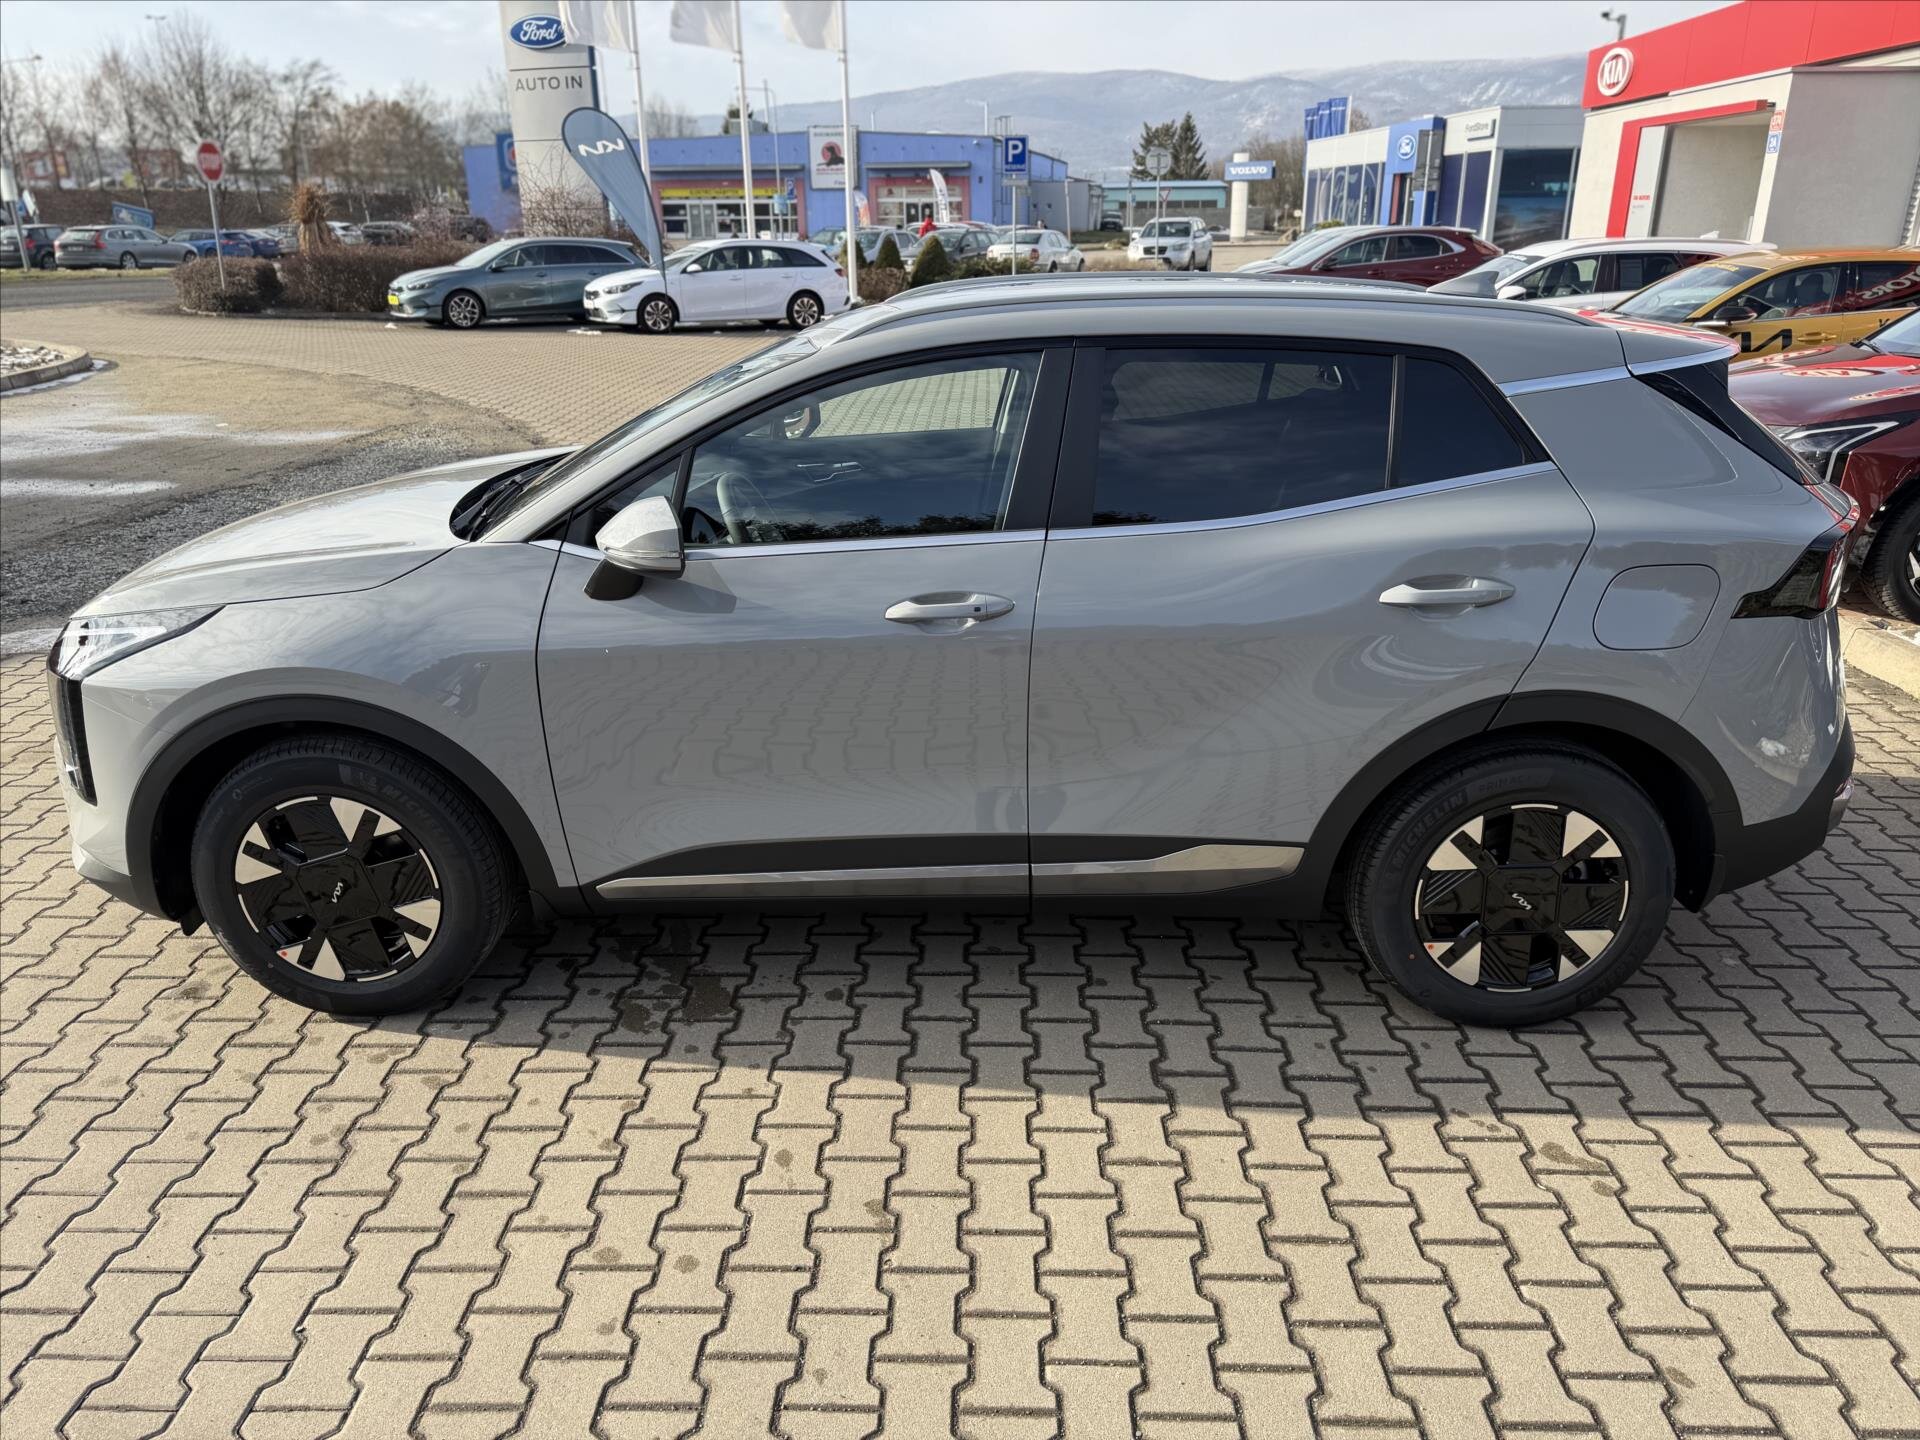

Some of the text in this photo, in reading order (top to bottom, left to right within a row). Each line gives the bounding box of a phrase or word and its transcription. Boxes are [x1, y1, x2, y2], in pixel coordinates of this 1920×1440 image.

[520, 20, 558, 41] Ford
[1603, 59, 1623, 84] KIA
[515, 76, 583, 91] AUTO IN
[1008, 140, 1023, 162] P
[1229, 165, 1268, 176] VOLVO
[1391, 790, 1464, 869] MICHELIN
